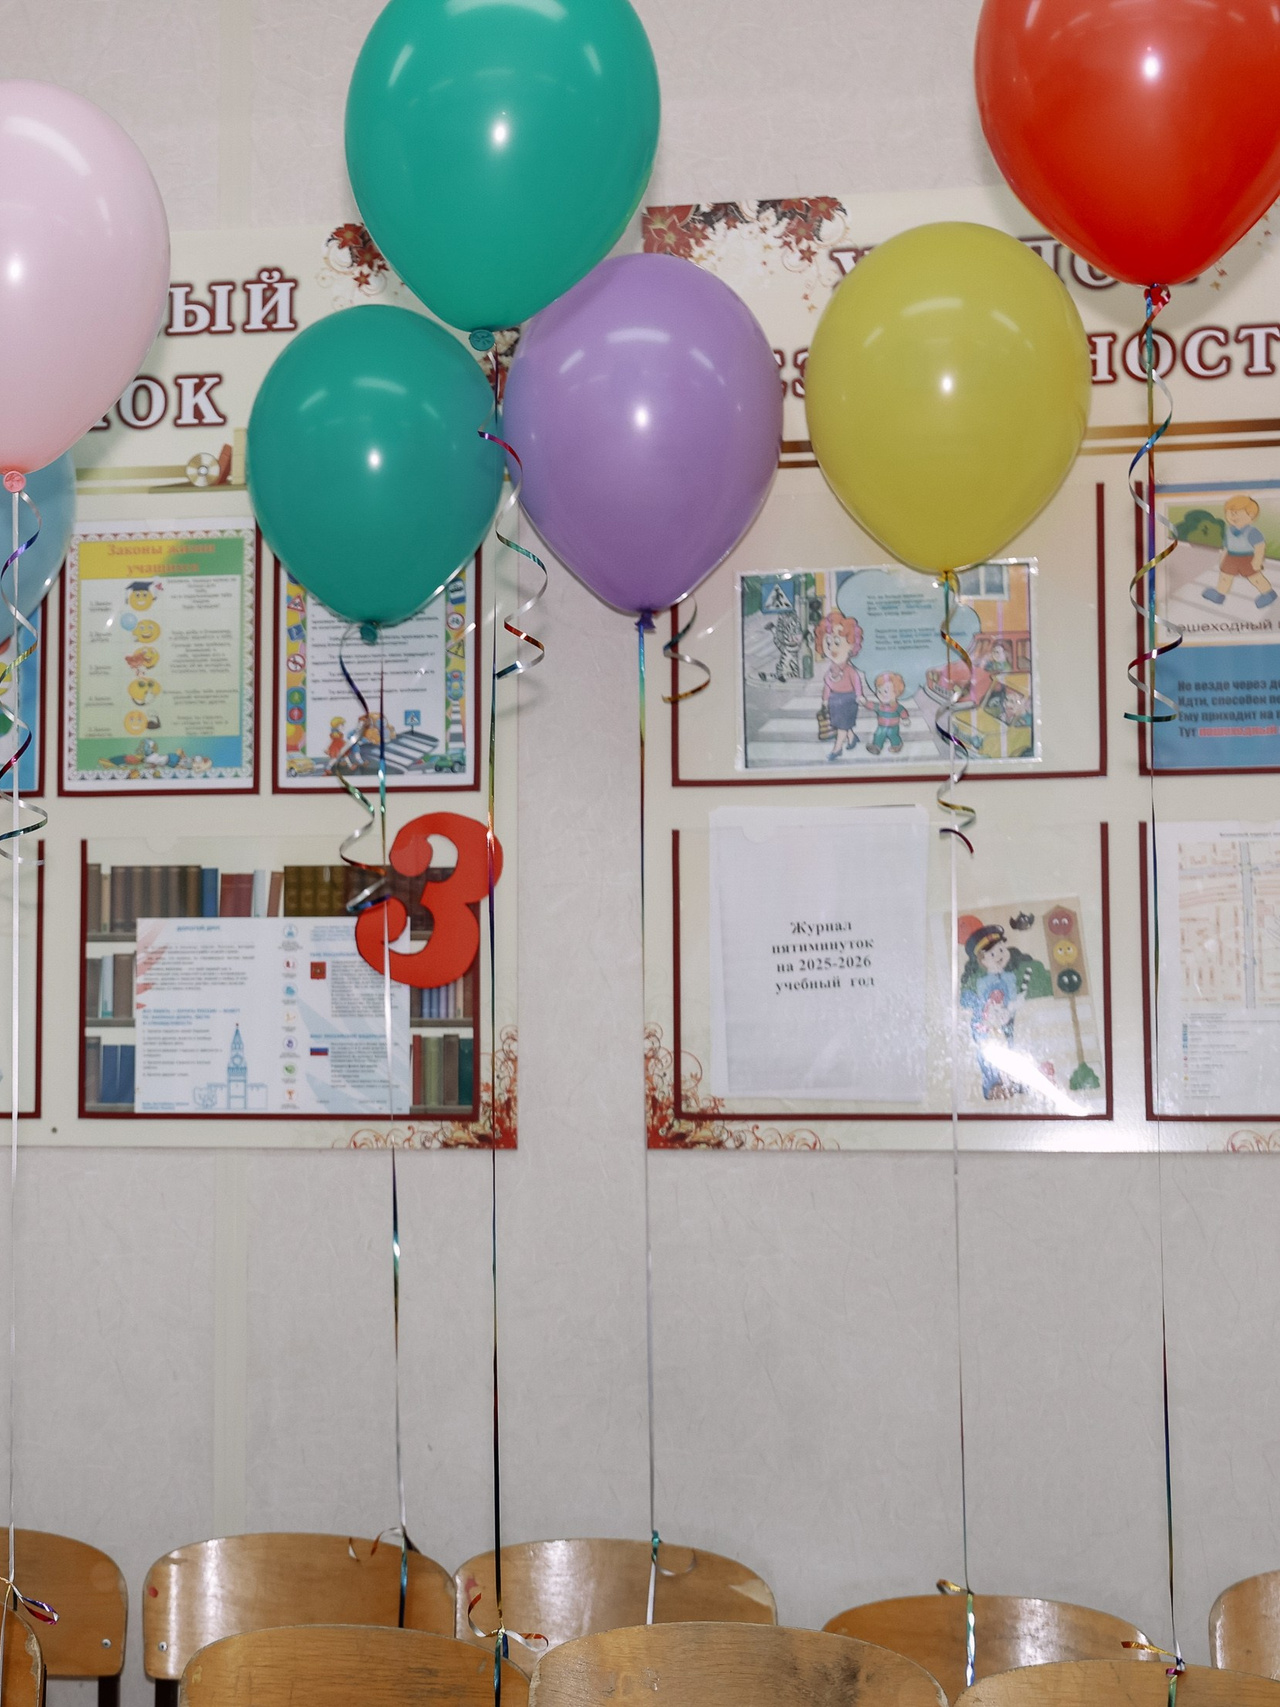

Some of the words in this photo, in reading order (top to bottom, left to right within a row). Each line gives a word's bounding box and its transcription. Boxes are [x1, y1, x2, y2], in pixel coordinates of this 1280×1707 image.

[107, 544, 162, 556] Законы
[126, 563, 200, 577] учащихся
[1177, 680, 1192, 691] Не
[1194, 681, 1230, 692] везде
[1232, 680, 1267, 691] через
[1177, 696, 1209, 708] Идти,
[1211, 694, 1267, 706] способен
[1178, 712, 1199, 723] Ему
[1201, 711, 1257, 722] приходит
[1260, 711, 1274, 720] на
[1178, 726, 1196, 738] Тут
[790, 920, 852, 936] Журнал
[772, 938, 874, 955] пятиминуток
[776, 962, 794, 974] на
[799, 954, 872, 973] 2025-2026
[775, 975, 841, 995] учебный
[850, 976, 874, 989] год
